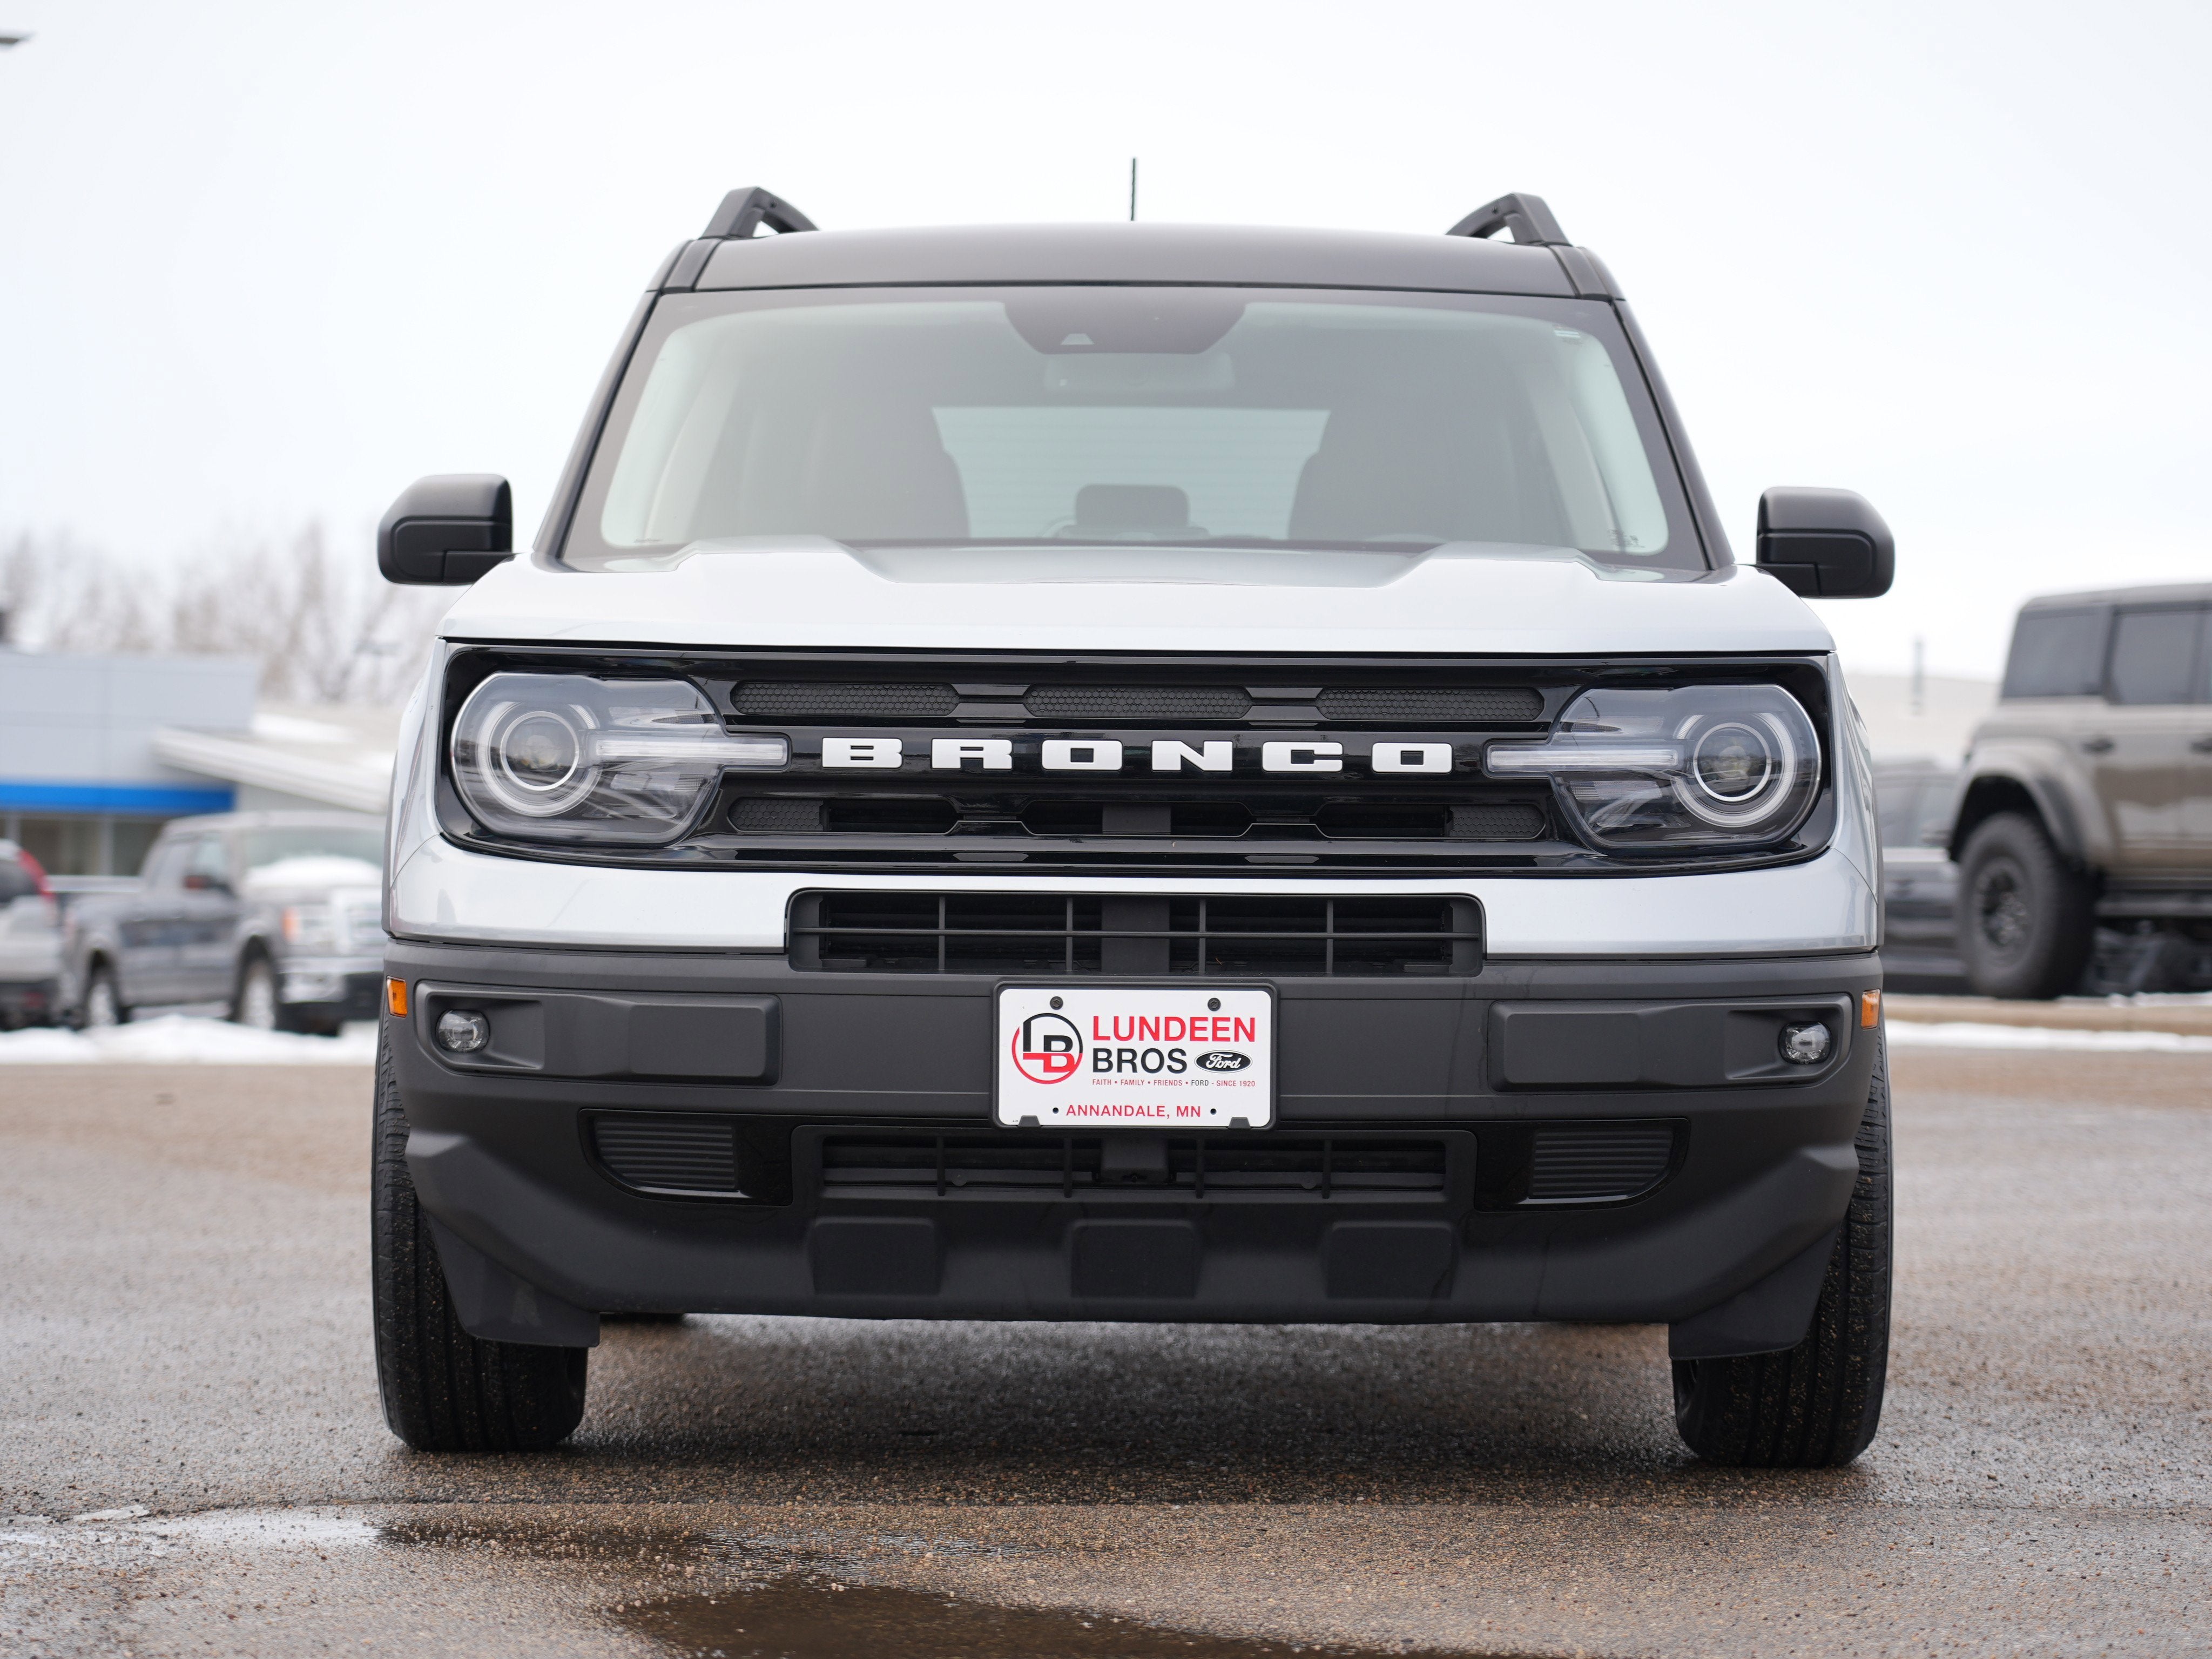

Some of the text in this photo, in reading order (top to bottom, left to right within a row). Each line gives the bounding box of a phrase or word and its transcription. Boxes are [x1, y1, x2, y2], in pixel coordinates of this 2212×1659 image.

[821, 737, 1453, 774] BRONCO
[1092, 1016, 1256, 1042] LUNDEEN
[1092, 1048, 1188, 1074] BROS
[1205, 1053, 1242, 1069] Ford
[1066, 1104, 1201, 1119] ANNANDALE, MN
